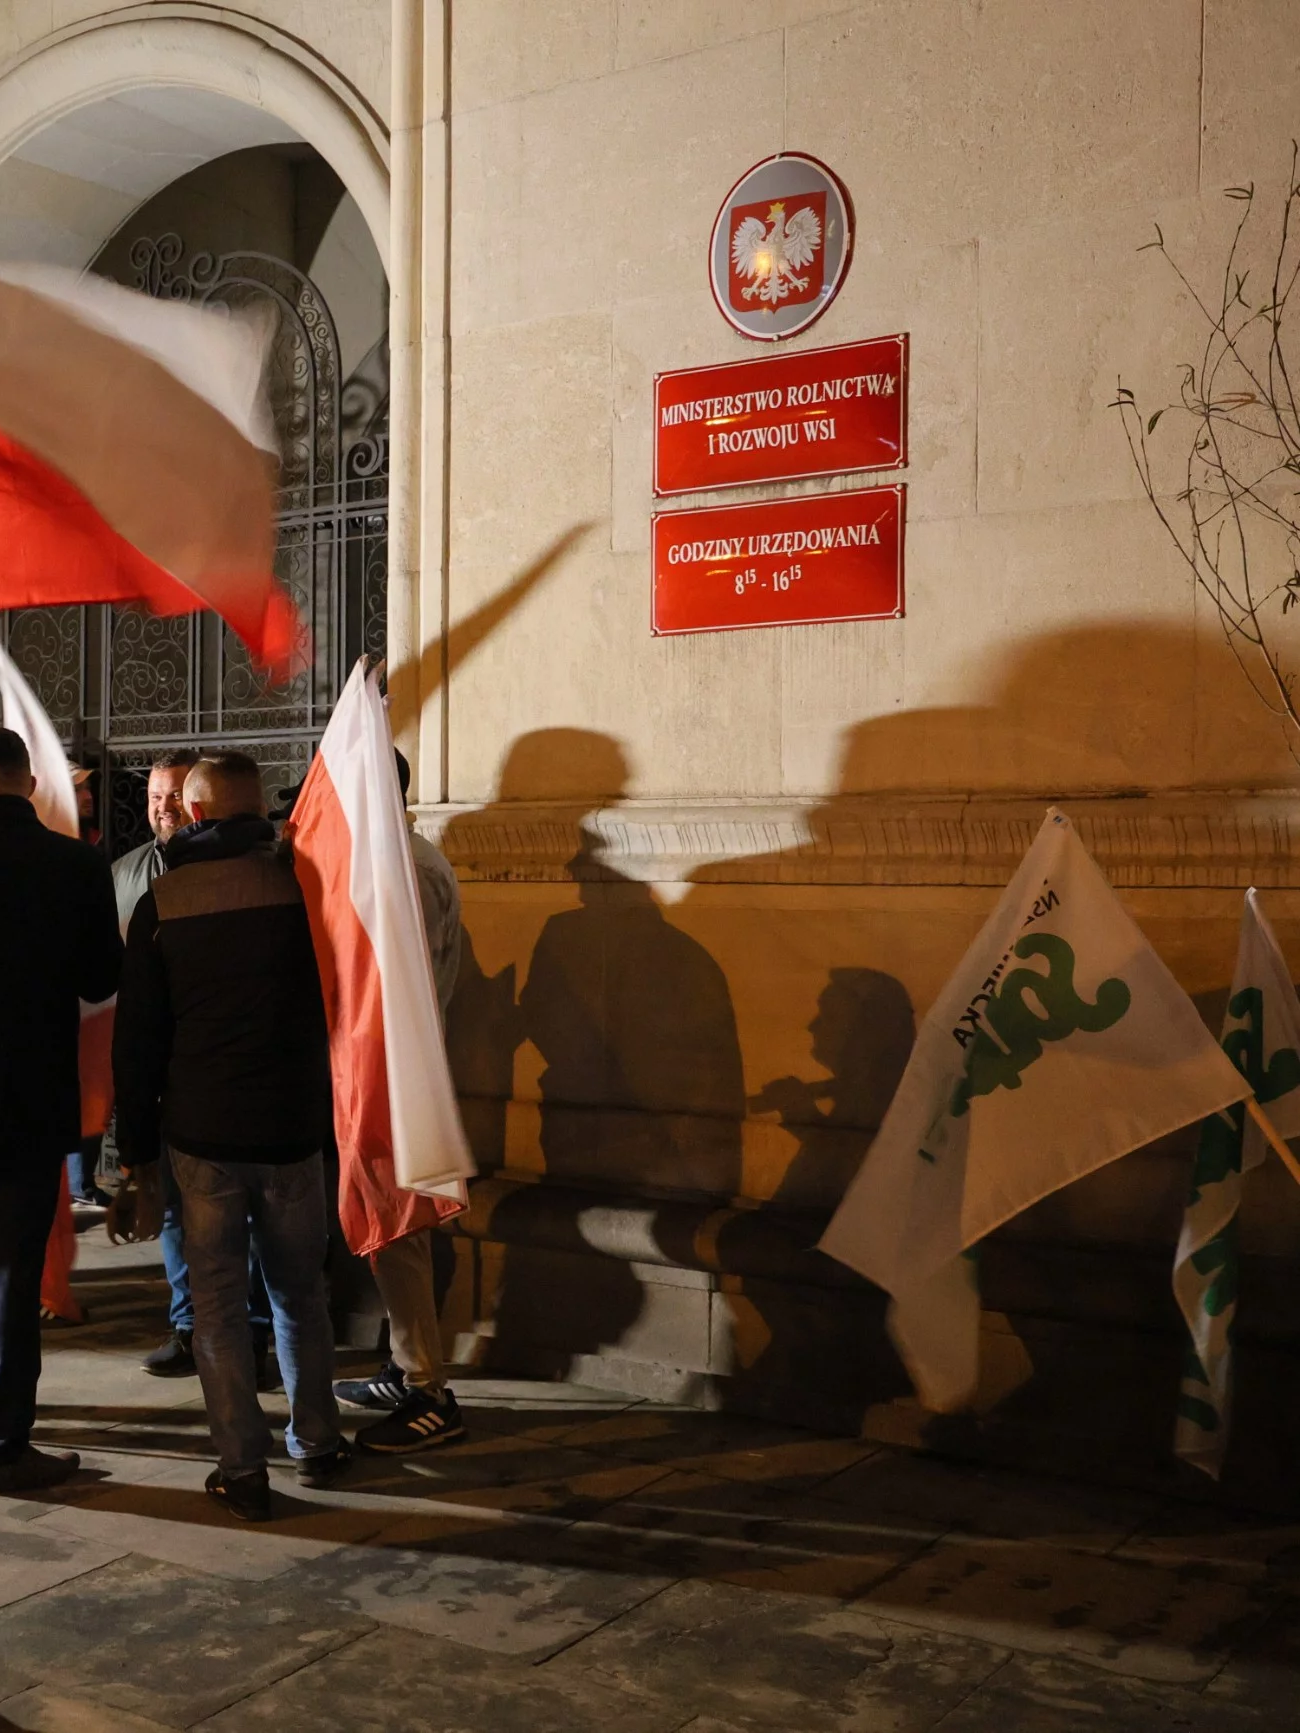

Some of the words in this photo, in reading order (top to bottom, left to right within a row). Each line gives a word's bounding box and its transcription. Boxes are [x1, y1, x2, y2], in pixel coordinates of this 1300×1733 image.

[661, 388, 782, 427] MINISTERSTWO
[787, 373, 895, 407] ROLNICTWA
[708, 434, 715, 455] I
[718, 422, 799, 454] ROZWOJU
[803, 418, 836, 442] WSI
[668, 536, 745, 565] GODZINY
[748, 523, 880, 557] URZĘDOWANIA
